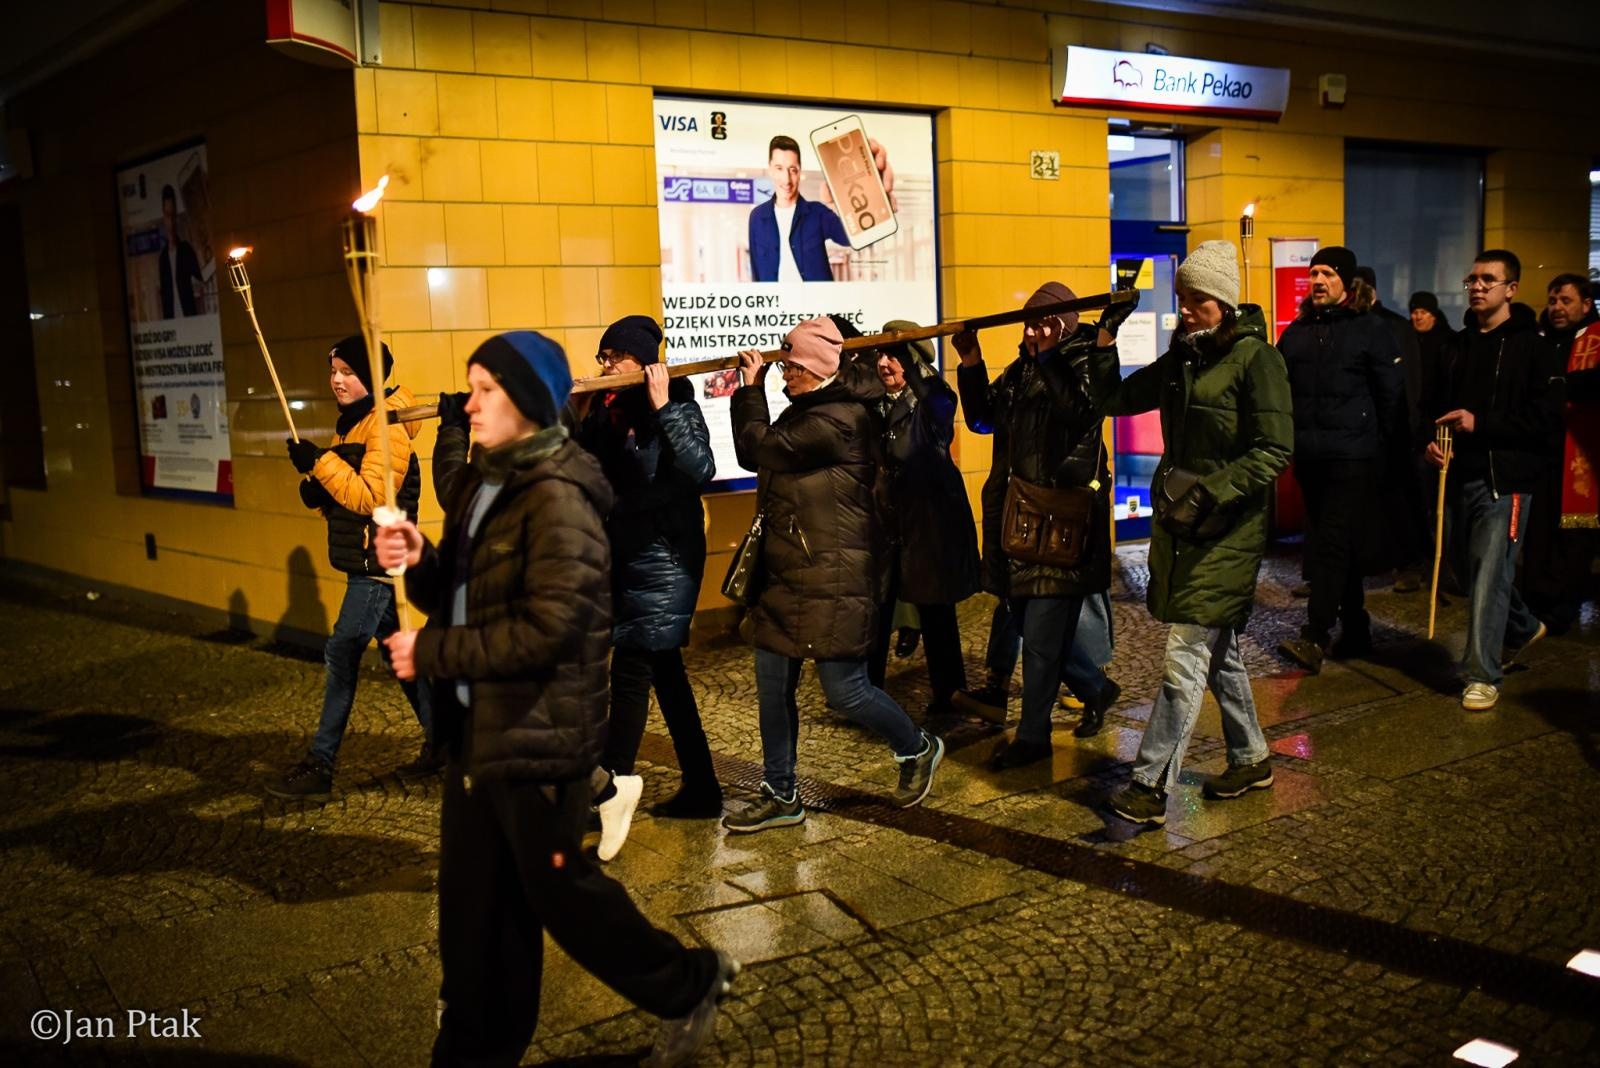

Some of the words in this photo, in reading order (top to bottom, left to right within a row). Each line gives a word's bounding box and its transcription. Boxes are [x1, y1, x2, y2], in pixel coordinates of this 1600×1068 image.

[1153, 68, 1197, 94] Bank
[1201, 73, 1253, 99] Pekao
[659, 114, 698, 132] VISA
[1033, 154, 1059, 176] 24
[663, 293, 716, 309] WEJDŹ
[720, 296, 742, 308] DO
[745, 295, 780, 308] GRY!
[664, 315, 714, 332] DZIĘKI
[717, 315, 751, 328] VISA
[665, 336, 687, 349] NA
